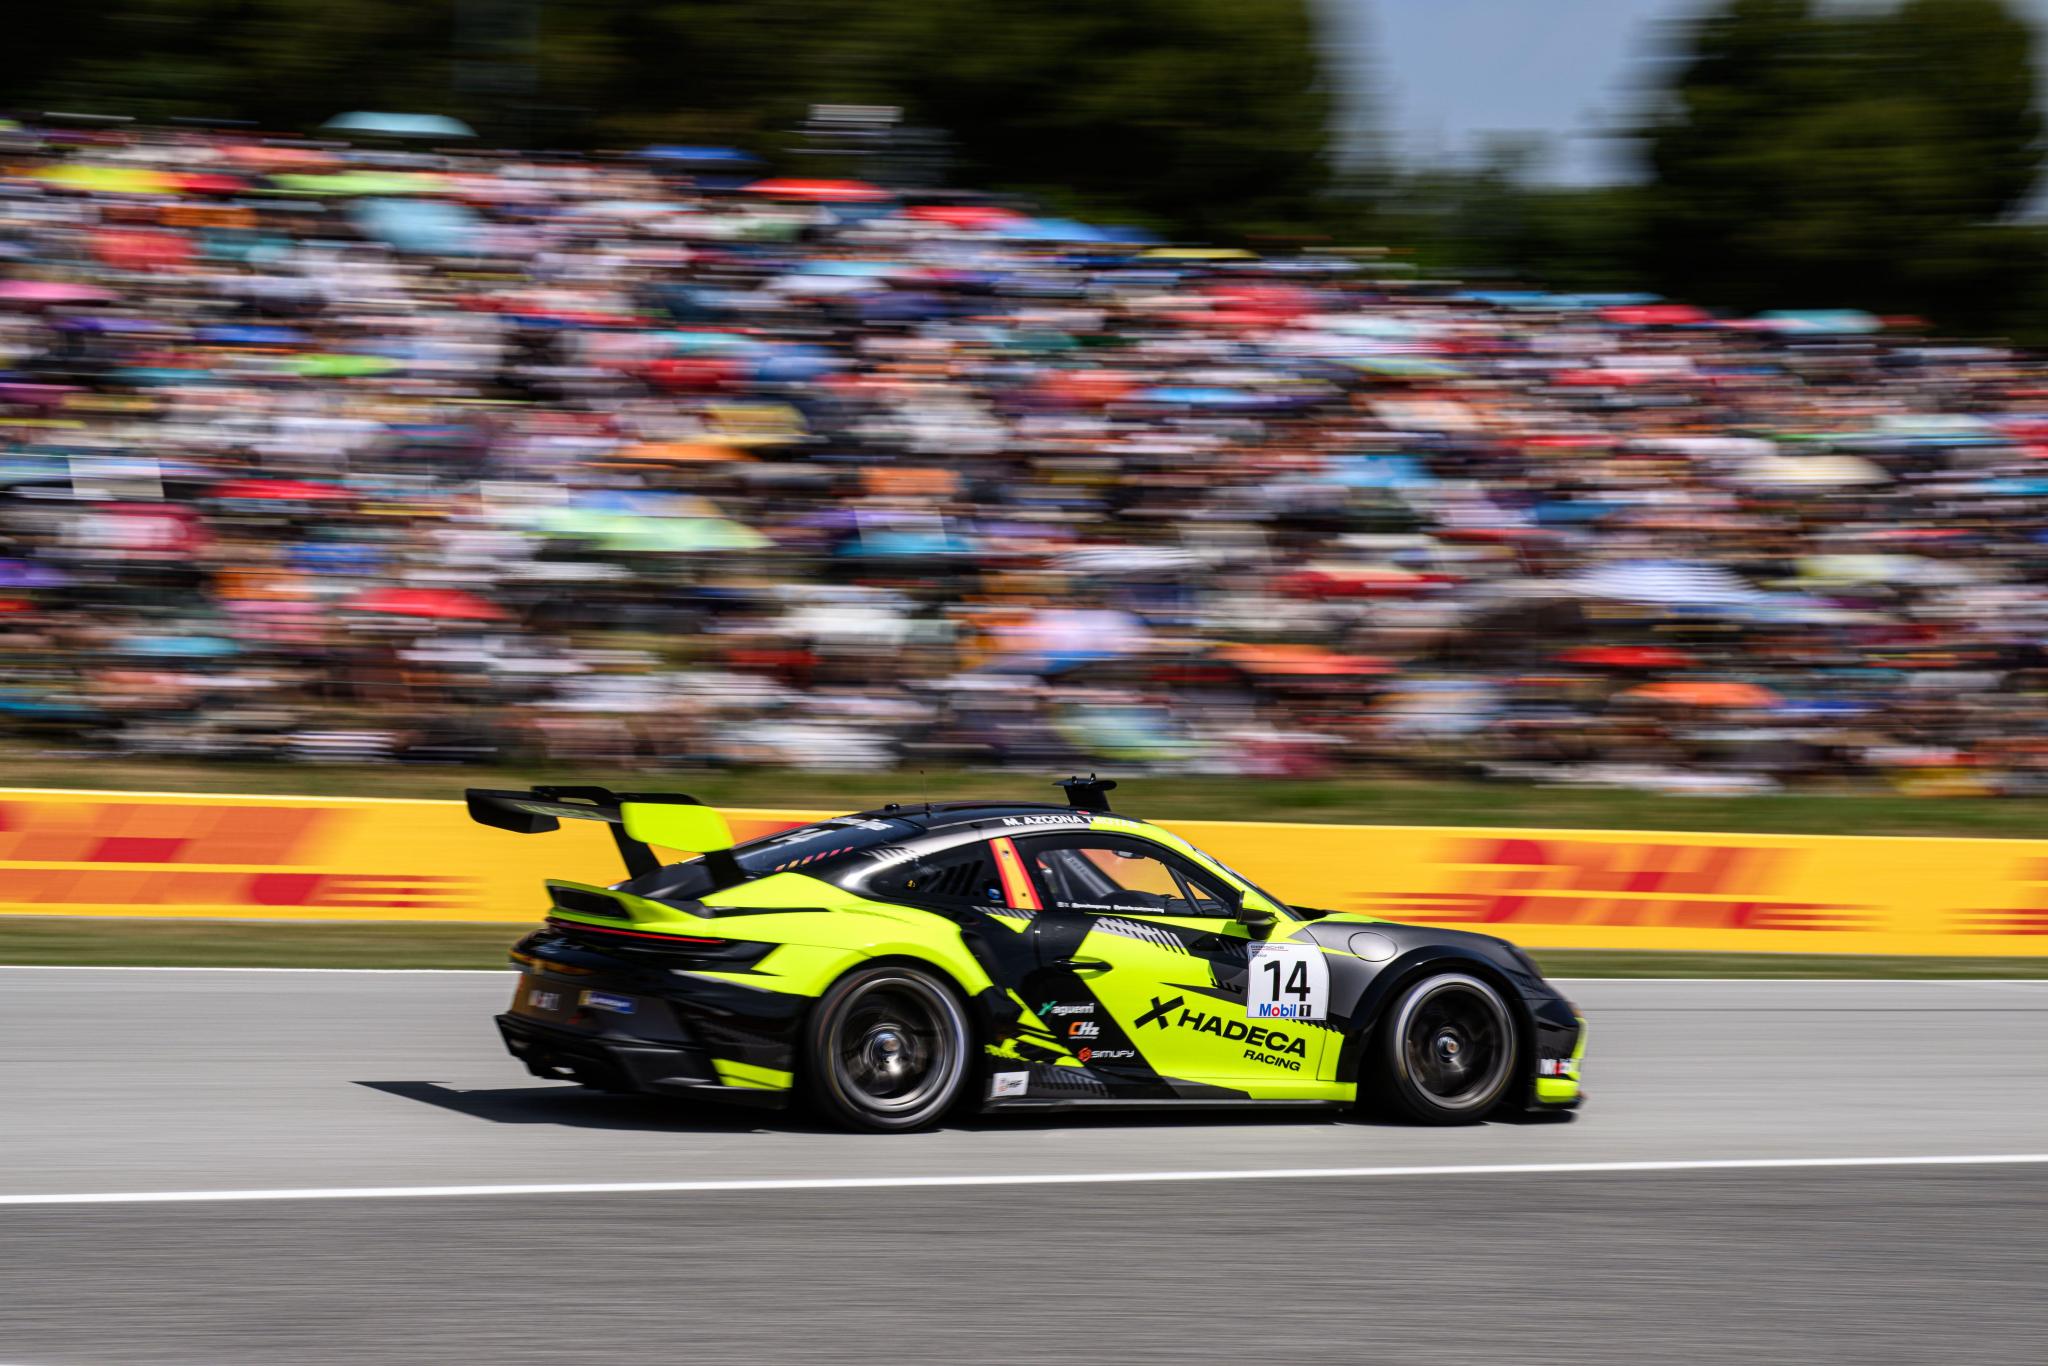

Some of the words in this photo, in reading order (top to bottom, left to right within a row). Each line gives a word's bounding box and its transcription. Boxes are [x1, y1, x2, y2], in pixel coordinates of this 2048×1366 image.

[1024, 815, 1084, 825] AZCONA
[1264, 960, 1311, 1002] 14
[1259, 1003, 1297, 1017] Mobil
[1301, 1005, 1310, 1017] 1
[1177, 1008, 1306, 1059] HADECA
[1243, 1049, 1302, 1072] RACING
